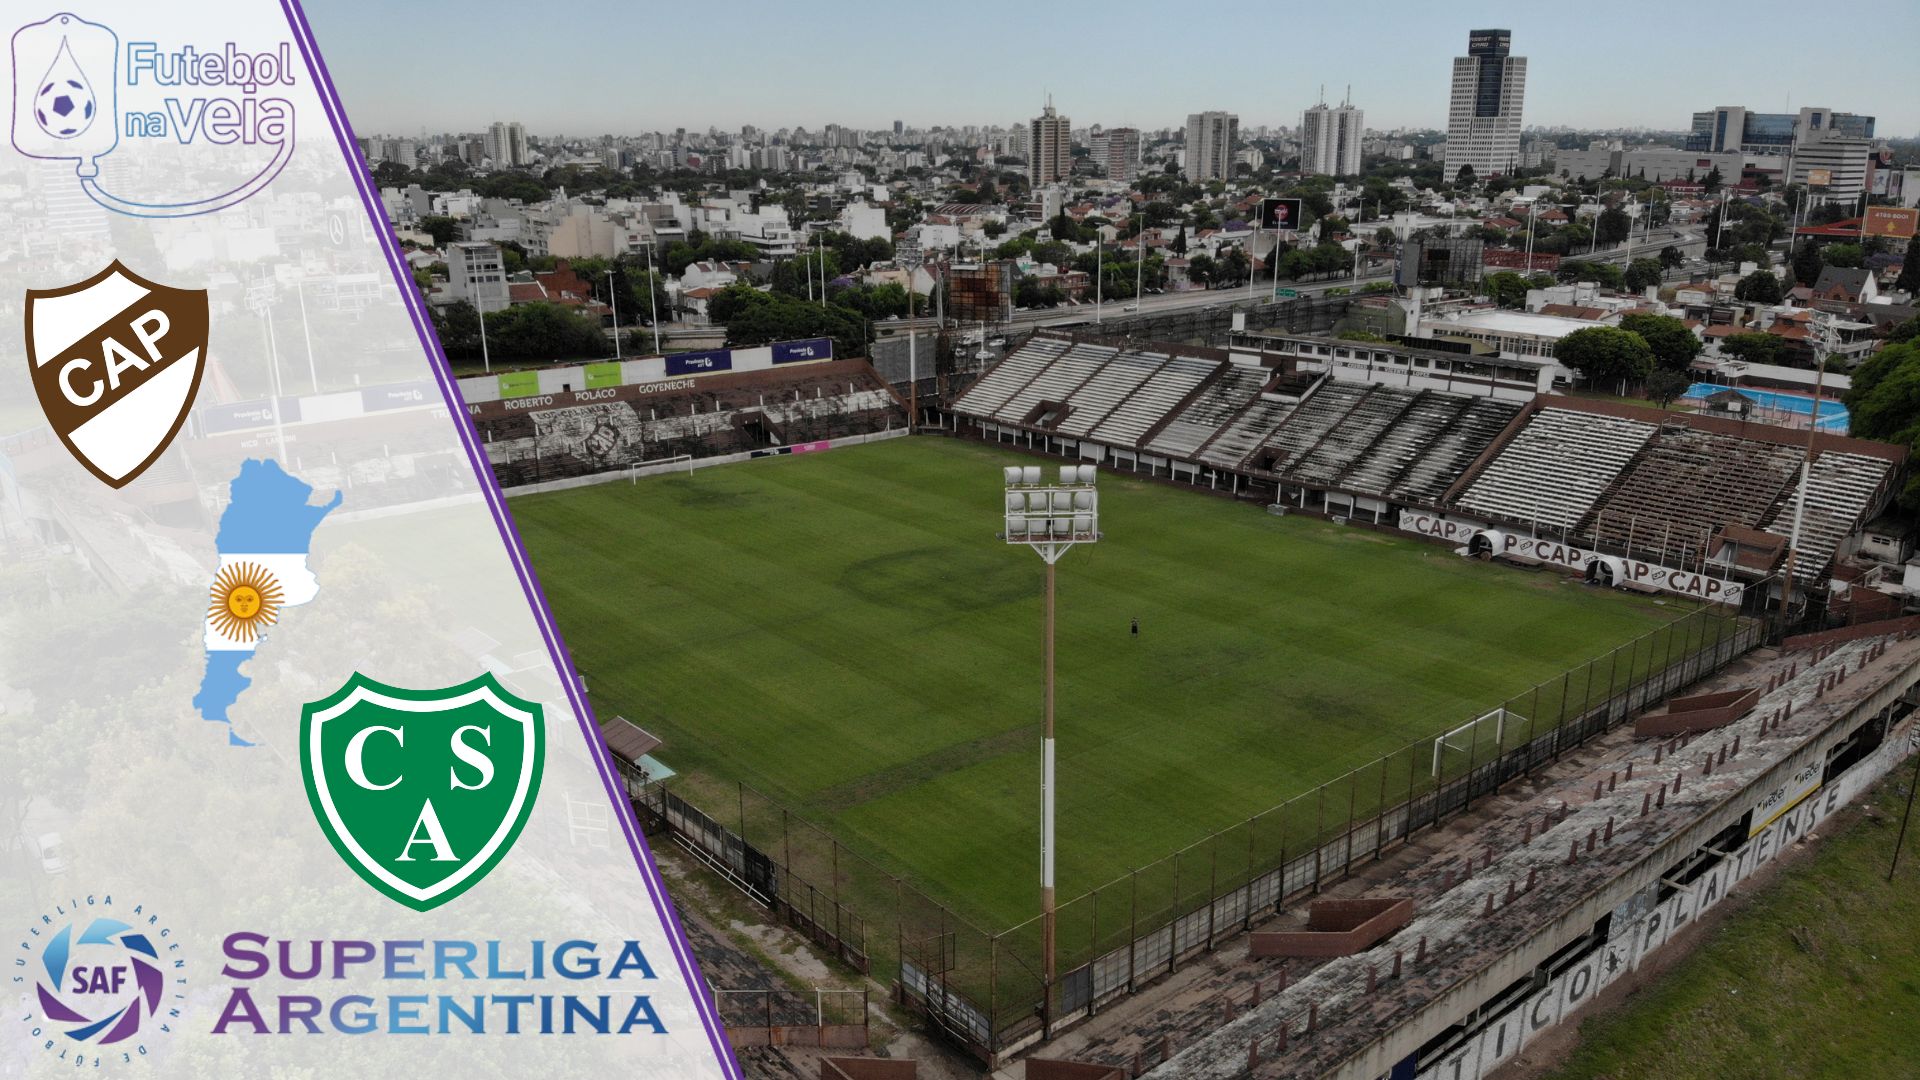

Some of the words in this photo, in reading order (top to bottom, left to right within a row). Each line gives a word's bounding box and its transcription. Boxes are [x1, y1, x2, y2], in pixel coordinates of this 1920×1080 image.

[504, 396, 553, 411] ROBERTO
[575, 388, 616, 402] POLACO
[639, 379, 696, 394] GOYENECHE
[1415, 516, 1457, 538] CAP
[1535, 541, 1581, 565] CAP
[1668, 571, 1721, 597] CAP
[1643, 783, 1841, 952] PLATENSE
